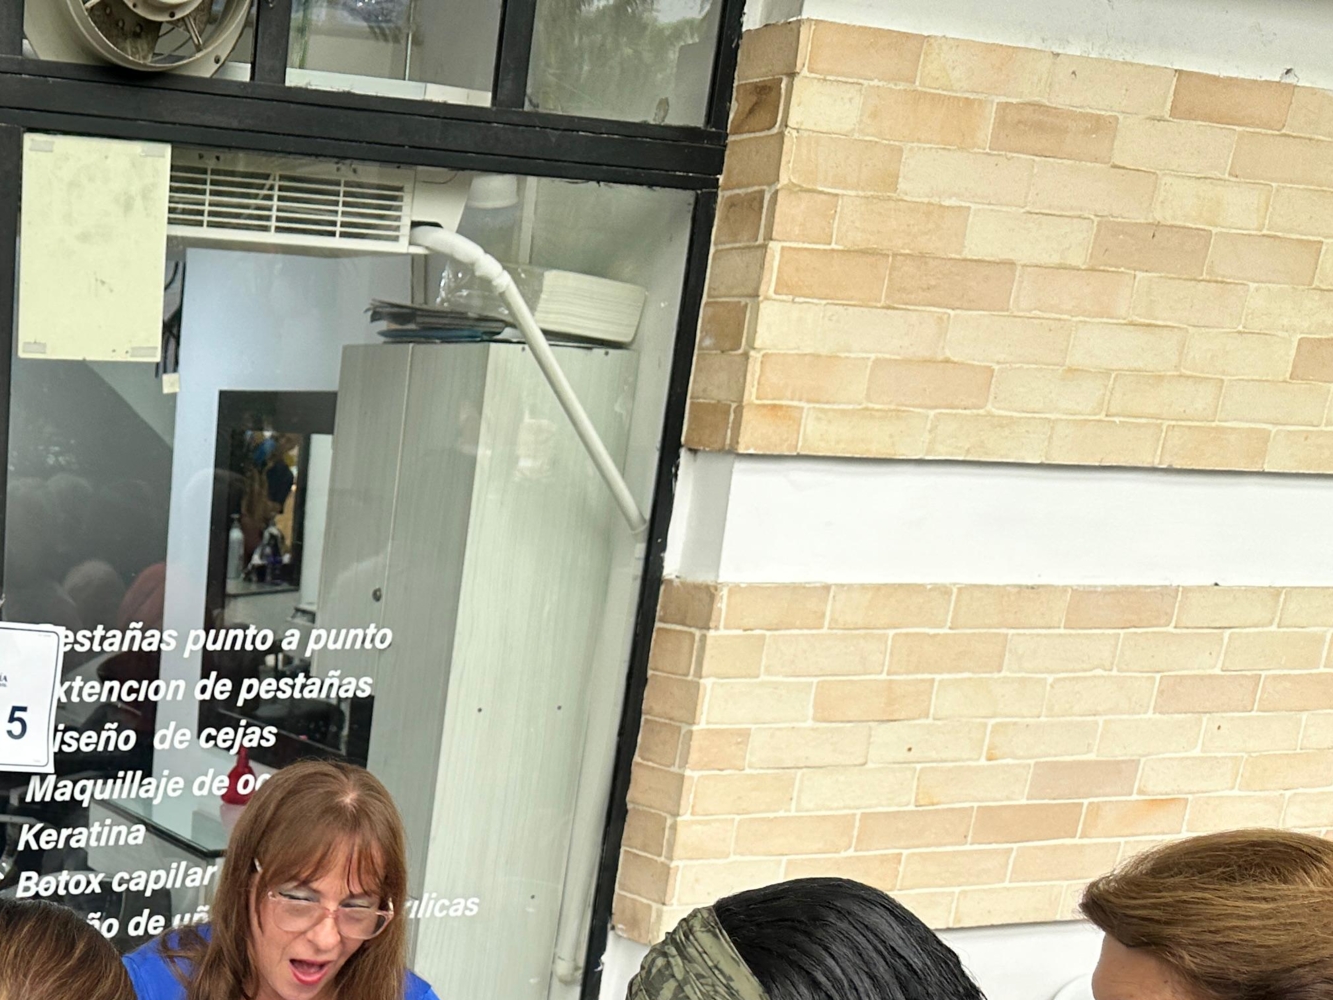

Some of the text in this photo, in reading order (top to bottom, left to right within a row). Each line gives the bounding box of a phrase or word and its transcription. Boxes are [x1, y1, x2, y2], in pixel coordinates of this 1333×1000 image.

[60, 621, 393, 658] estañas punto a punto
[54, 670, 374, 707] xtencion de pestañas
[6, 706, 28, 740] 5
[53, 719, 279, 756] iseño de cejas
[25, 770, 185, 807] Maquillaje
[192, 768, 230, 797] de
[17, 818, 147, 851] Keratina
[16, 860, 218, 898] Botox capilar
[127, 908, 166, 937] de
